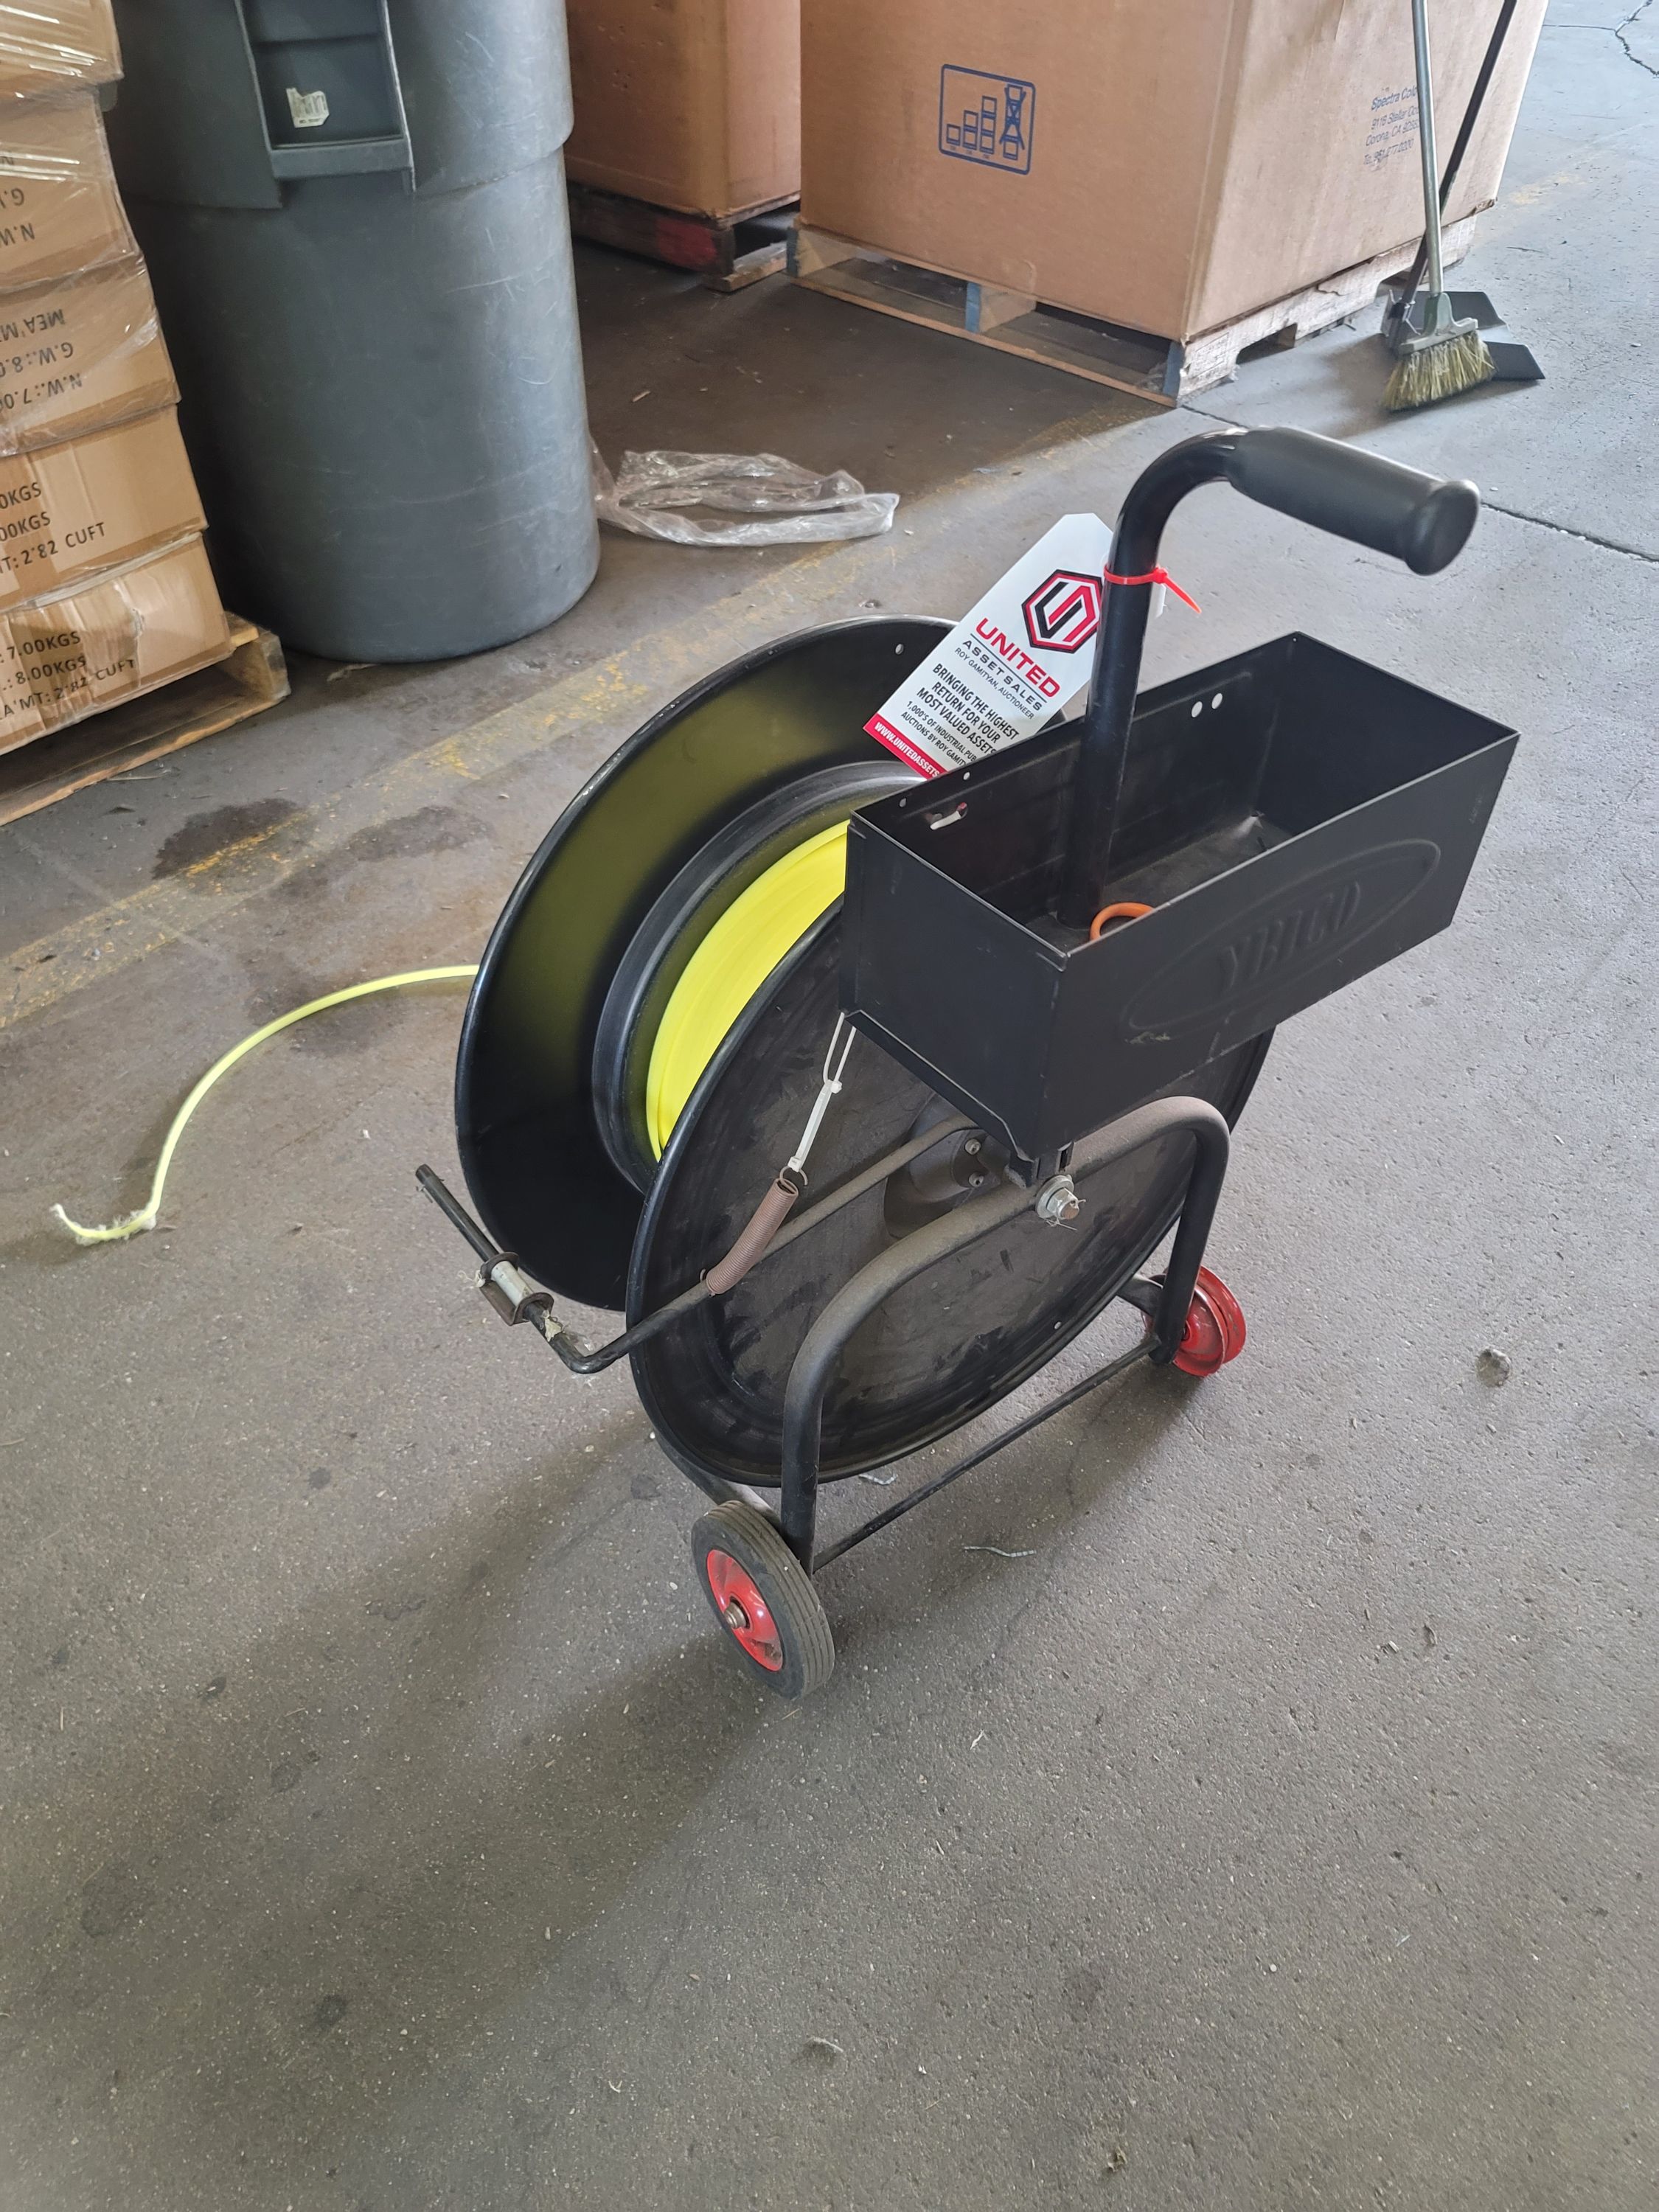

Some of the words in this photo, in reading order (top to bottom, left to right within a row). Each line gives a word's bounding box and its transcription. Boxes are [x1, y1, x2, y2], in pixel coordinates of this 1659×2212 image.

[1371, 93, 1400, 111] Spectra
[1391, 125, 1402, 137] CA
[0, 309, 65, 342] MEA'M
[65, 522, 105, 548] CUFT
[96, 658, 134, 681] CUFT
[962, 639, 1004, 675] ASSET
[1003, 675, 1042, 711] SALES
[975, 618, 1060, 697] UNITED
[932, 663, 974, 701] BRINGING
[970, 695, 989, 714] THE
[984, 709, 1020, 740] HIGHEST
[954, 647, 970, 661] ROY
[967, 658, 998, 689] GAMITYAN,
[998, 686, 1034, 720] AUCTIONEER
[916, 686, 943, 711] MOST
[939, 705, 970, 735] VALUED
[931, 681, 965, 712] RETURN
[961, 707, 981, 726] FOR
[976, 720, 1001, 744] YOUR
[900, 711, 930, 737] AUCTIONS
[926, 732, 938, 742] BY
[933, 739, 949, 752] ROY
[945, 748, 967, 766] GAMIT
[926, 717, 937, 727] OF
[933, 724, 966, 754] INDUSTRIAL
